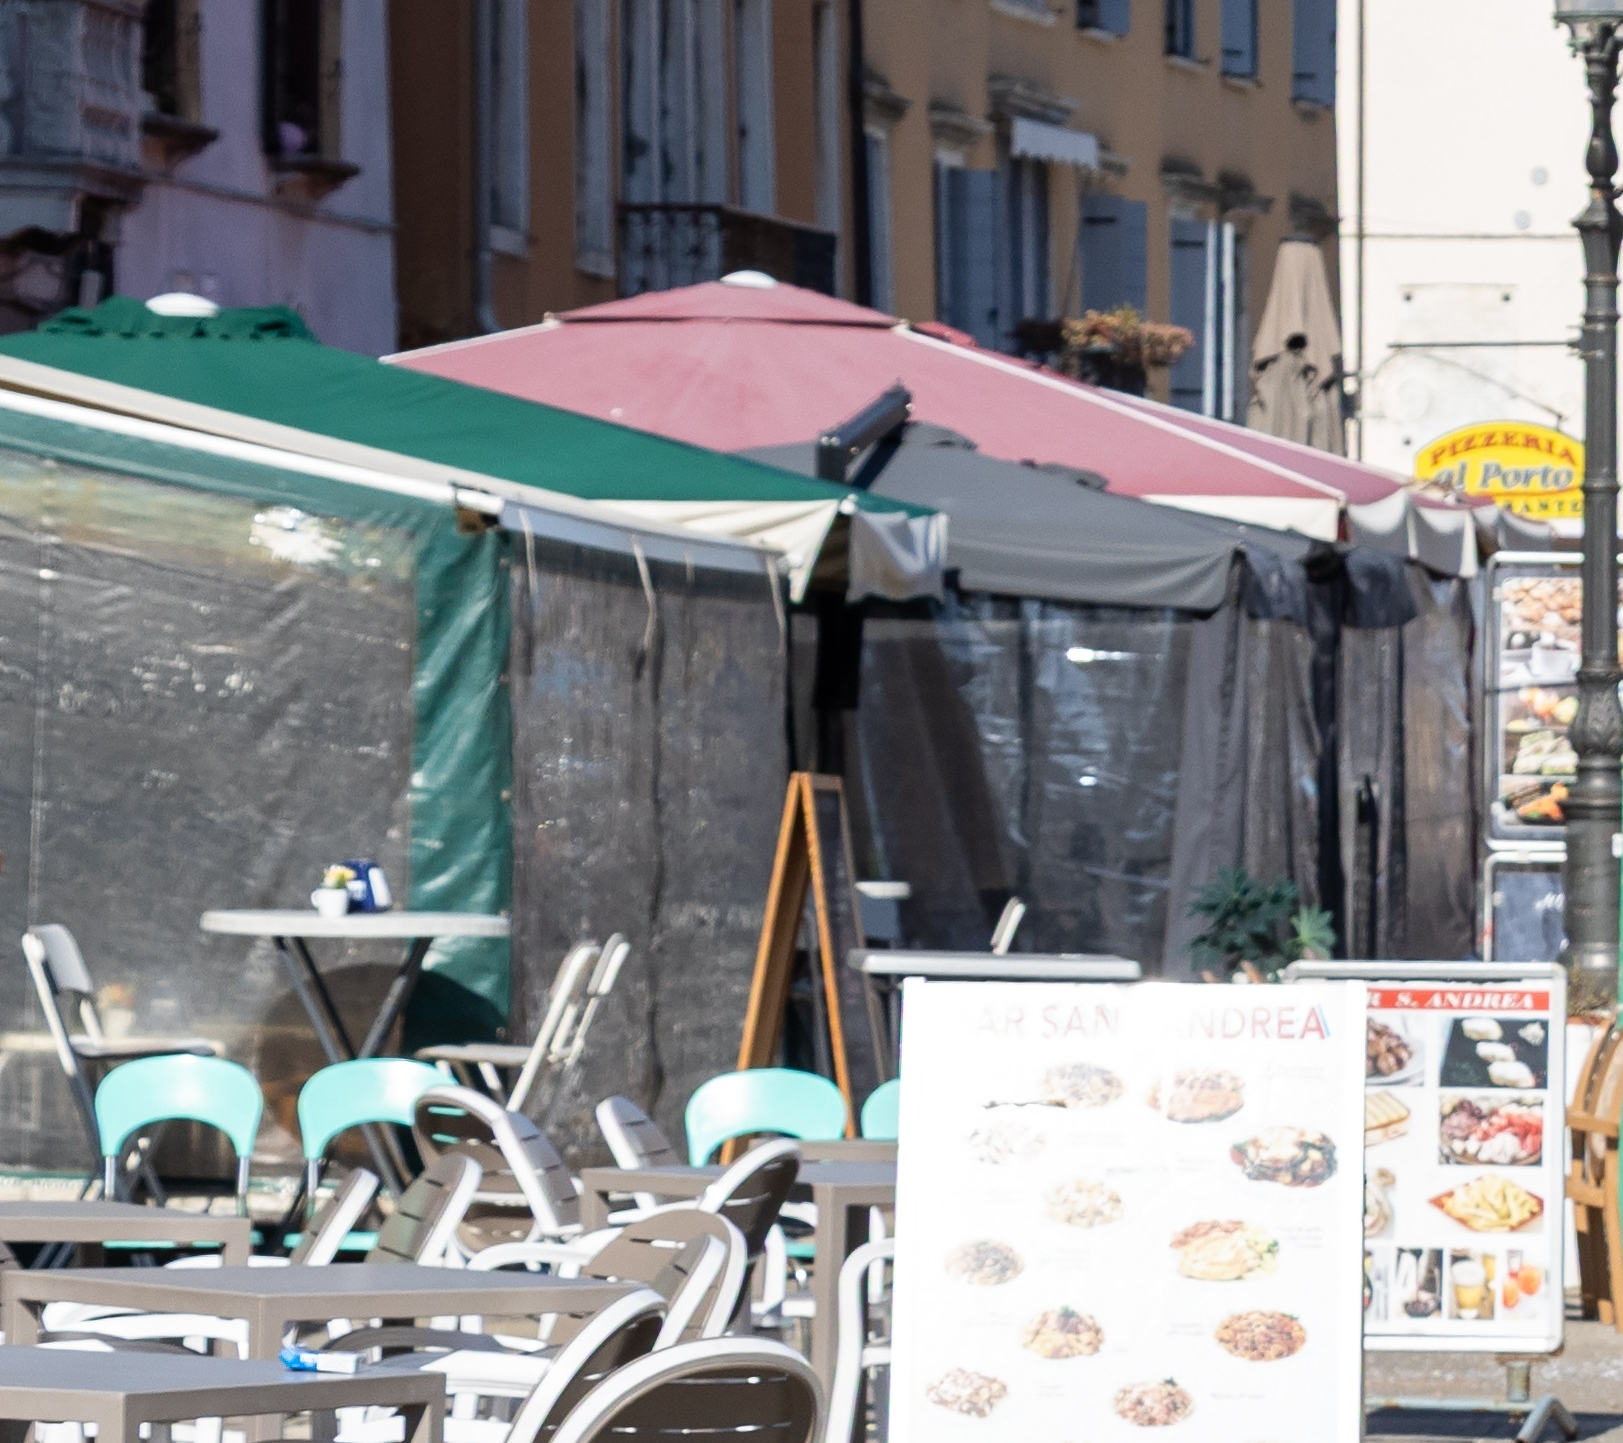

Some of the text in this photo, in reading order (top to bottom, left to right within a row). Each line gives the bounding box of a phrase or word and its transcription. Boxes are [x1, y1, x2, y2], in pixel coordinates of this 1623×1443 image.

[1430, 430, 1577, 467] PIZZERIA
[1436, 460, 1574, 489] al Porto
[1395, 991, 1419, 1007] S.
[1425, 991, 1535, 1009] ANDREA
